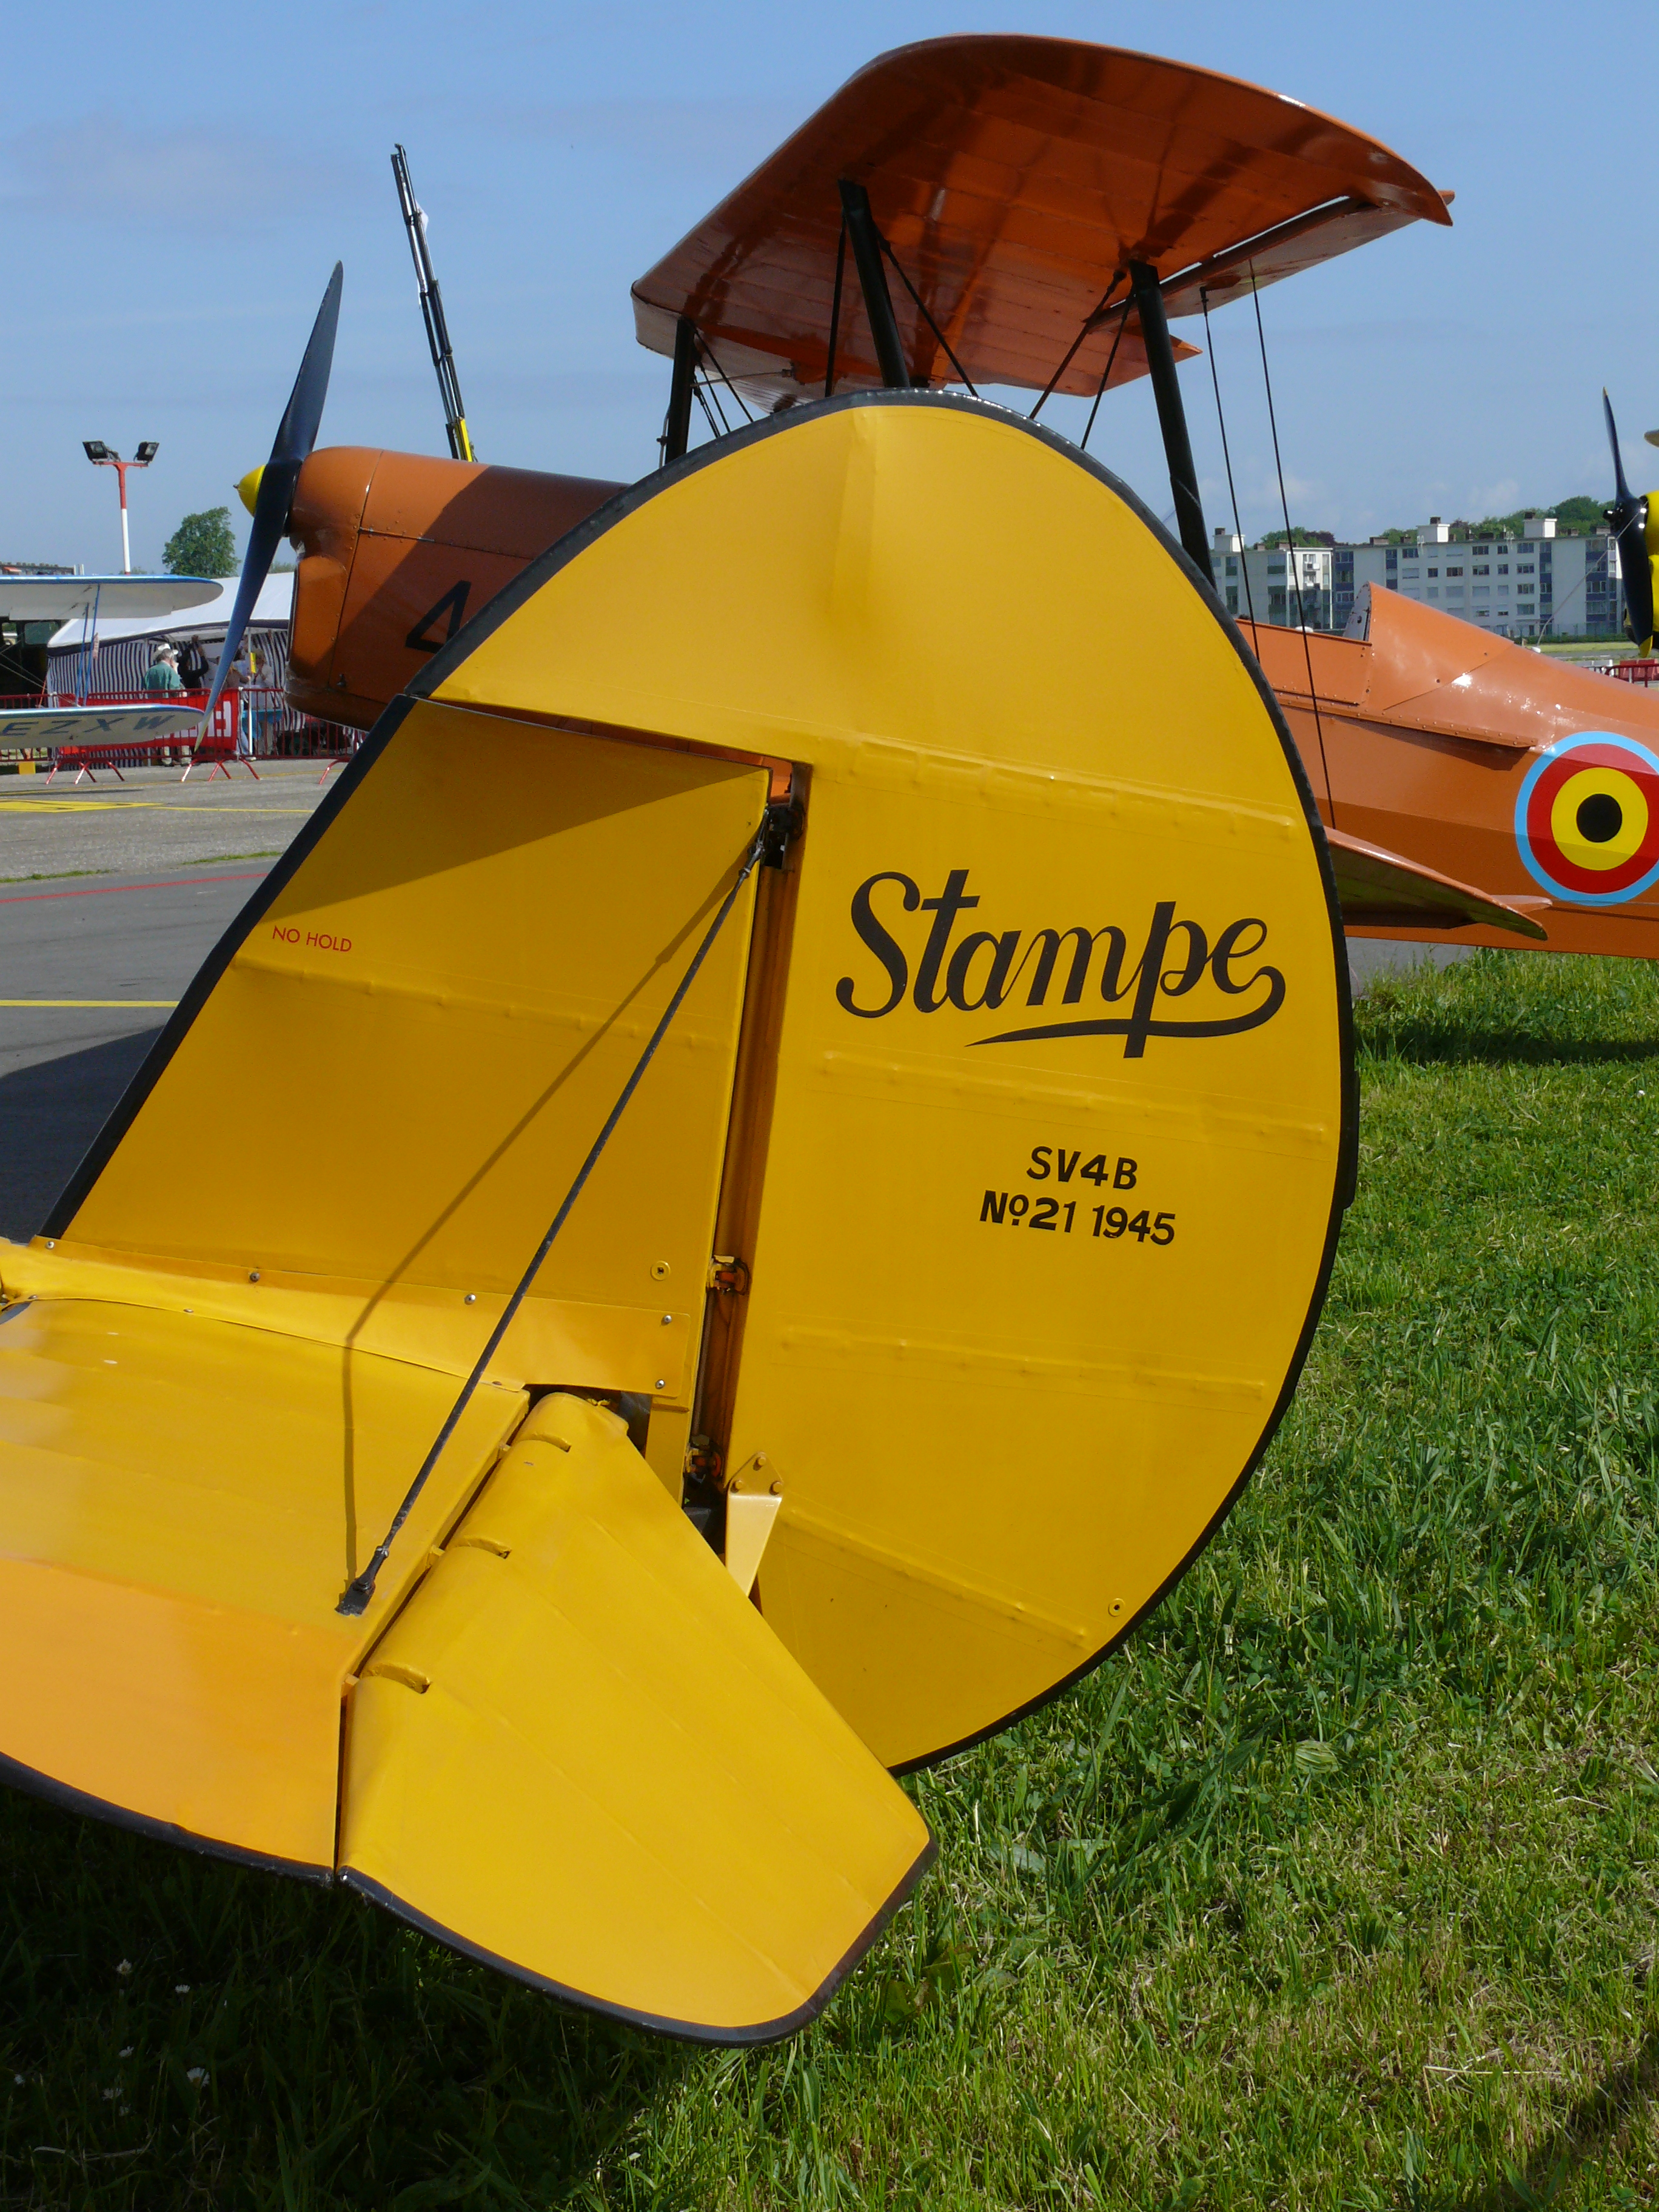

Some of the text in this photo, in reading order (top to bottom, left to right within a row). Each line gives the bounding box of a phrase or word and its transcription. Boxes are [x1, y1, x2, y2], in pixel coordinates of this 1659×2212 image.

[2, 715, 175, 736] EZXW
[272, 925, 352, 952] NO HOLD
[836, 869, 1286, 1059] Stampe
[1026, 1145, 1138, 1190] SV4B
[1092, 1204, 1176, 1245] 1945
